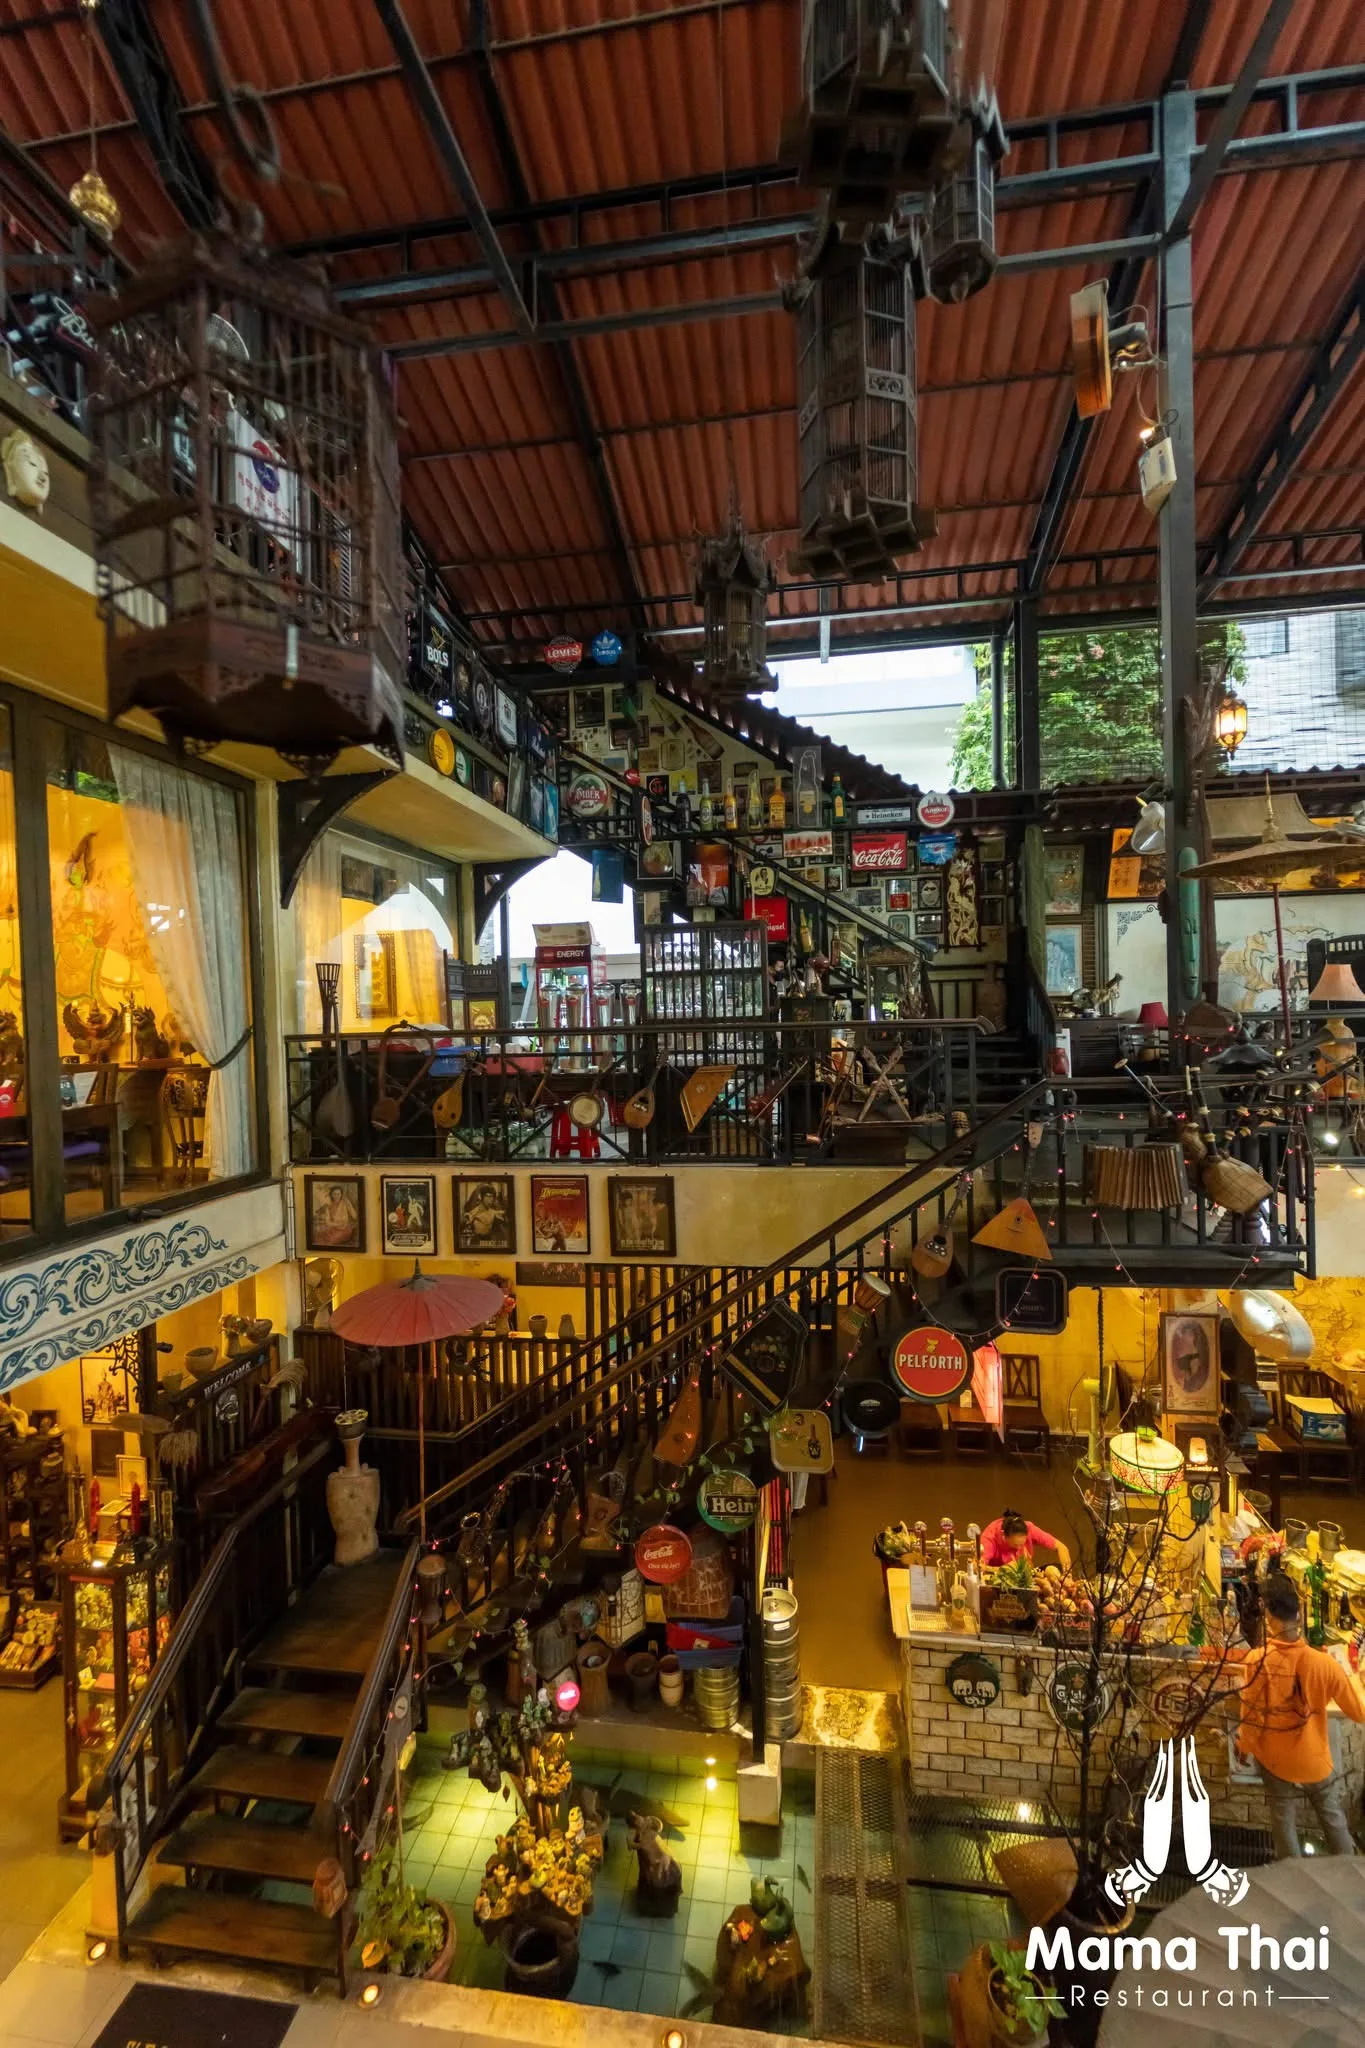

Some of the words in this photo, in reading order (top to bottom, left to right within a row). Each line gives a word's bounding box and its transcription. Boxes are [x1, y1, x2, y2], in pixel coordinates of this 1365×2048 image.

[426, 645, 449, 668] BOLS
[871, 811, 904, 819] Heineken
[855, 848, 904, 867] Coca-Cola
[556, 950, 585, 958] ENERGY
[899, 1353, 963, 1370] PELFORTH
[203, 1360, 252, 1396] WELCOME
[711, 1497, 757, 1513] Hein
